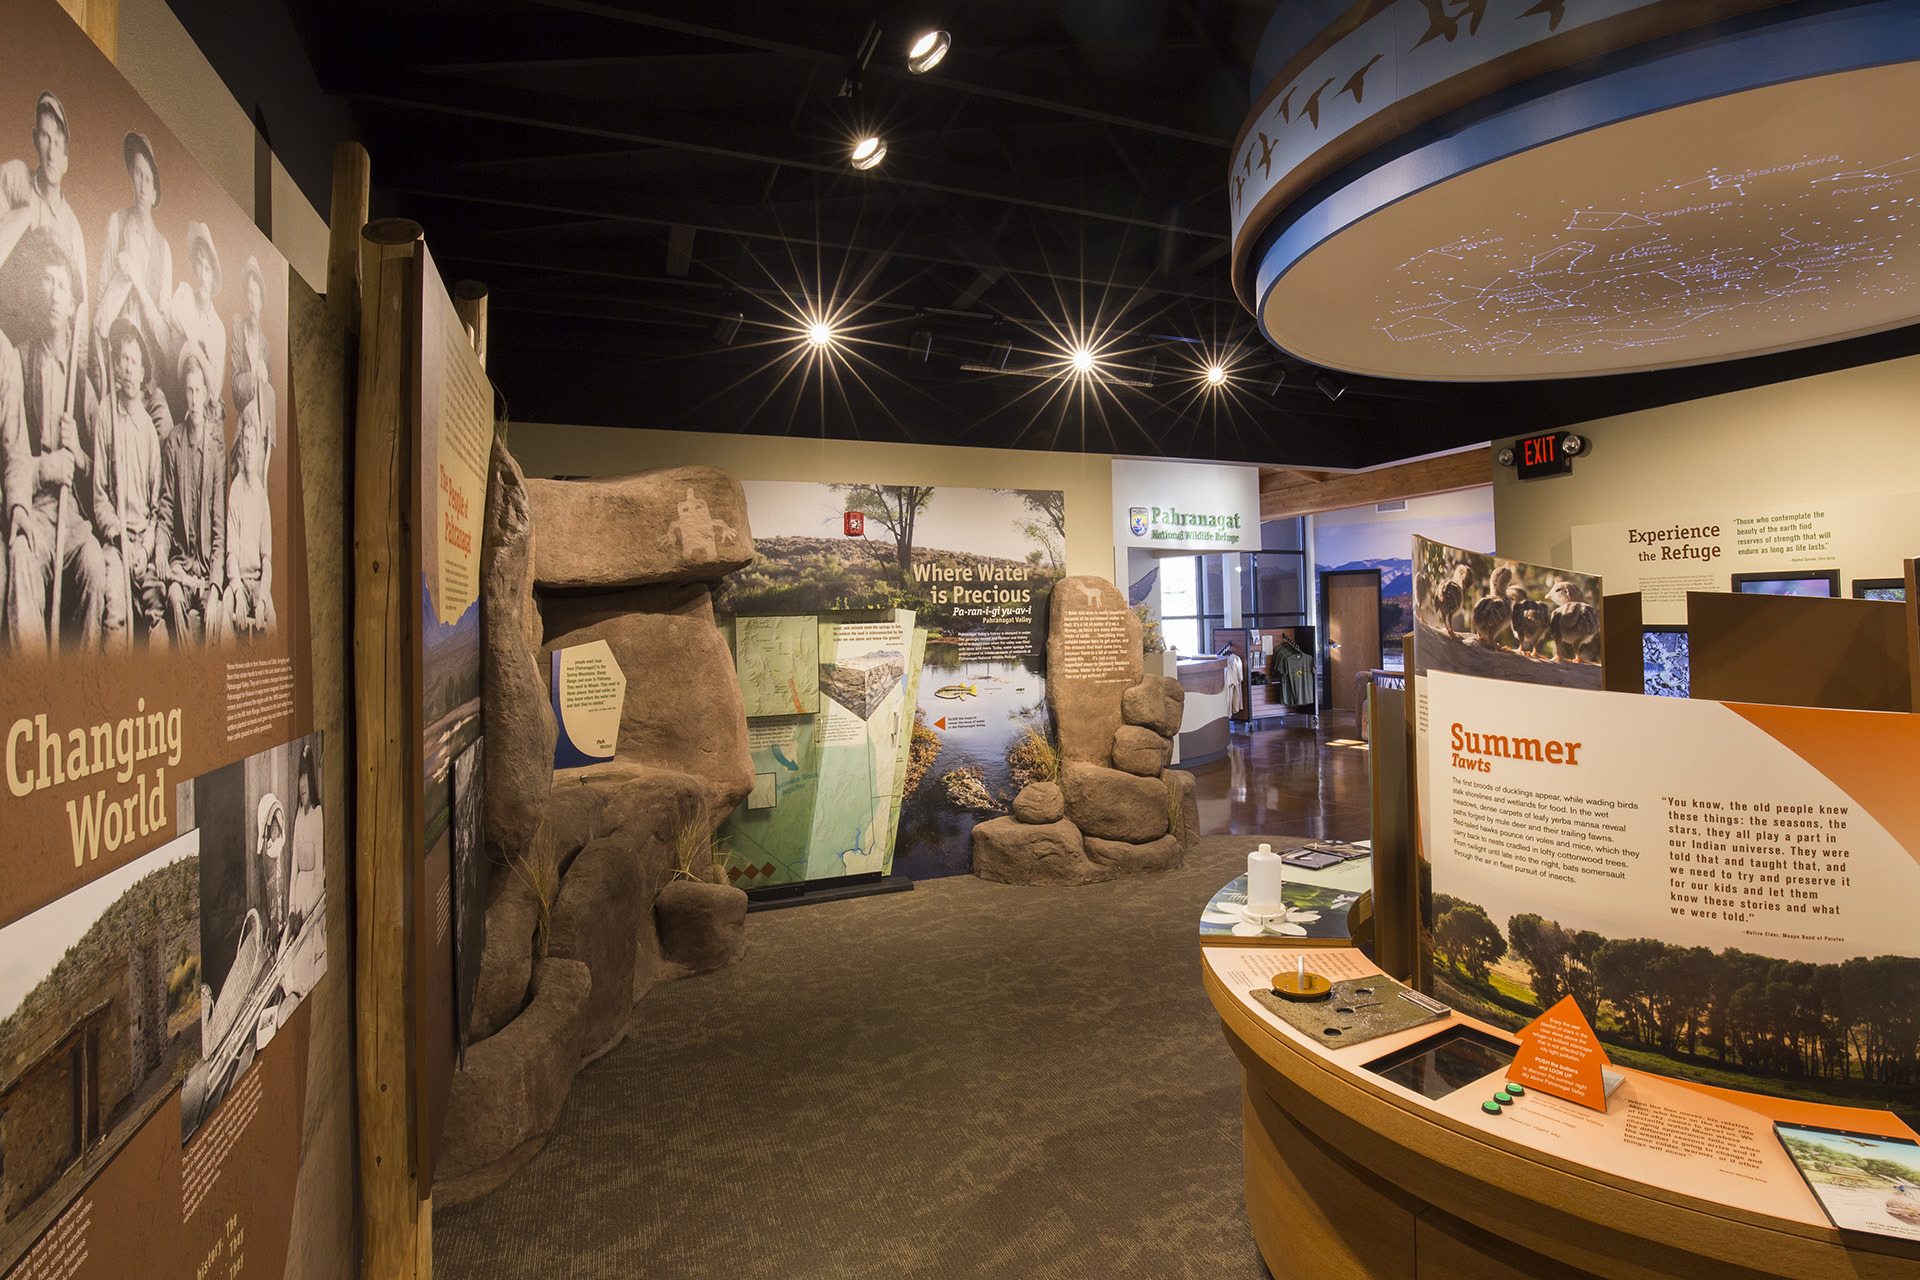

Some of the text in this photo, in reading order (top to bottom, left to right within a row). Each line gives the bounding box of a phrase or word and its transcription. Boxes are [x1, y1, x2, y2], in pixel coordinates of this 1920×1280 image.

[1717, 154, 1840, 183] Cassiopeia
[1832, 178, 1903, 196] Perseus
[1645, 201, 1732, 220] Cepheus
[1441, 237, 1504, 253] Cygnus
[1524, 436, 1555, 466] EXIT
[440, 464, 468, 520] The People of
[1152, 506, 1240, 531] Pahranagat
[1756, 515, 1769, 524] who
[1771, 512, 1811, 522] contemplate
[445, 512, 471, 559] Pahranagat
[1152, 530, 1240, 544] National Wildlife Refuge
[1628, 525, 1720, 546] Experience
[1774, 534, 1801, 543] strength
[1638, 544, 1721, 561] the Refuge
[913, 563, 1030, 582] Where Water
[930, 585, 1031, 604] is Precious
[953, 605, 1032, 617] Pa-ran-i-gi yu-av-i
[6, 697, 182, 797] Changing
[1451, 722, 1582, 765] Summer
[1452, 753, 1491, 773] Tawts
[1462, 778, 1472, 786] first
[1474, 780, 1493, 790] broods
[1502, 785, 1533, 799] ducklings
[1535, 793, 1562, 802] appear,
[1564, 794, 1584, 804] while
[1586, 797, 1615, 809] wading
[1617, 799, 1638, 809] birds
[1507, 798, 1536, 808] wetlands
[1538, 801, 1547, 810] for
[1549, 803, 1568, 813] food.
[1570, 805, 1577, 814] In
[1580, 806, 1592, 816] the
[1594, 809, 1609, 818] wet
[1662, 797, 1848, 815] “You know, the old people knew
[66, 767, 167, 868] World
[1668, 811, 1846, 829] these things: the seasons, the
[1669, 825, 1701, 836] stars,
[1707, 827, 1730, 840] they
[1736, 830, 1750, 839] all
[1756, 831, 1779, 843] play
[1797, 833, 1821, 844] part
[1826, 834, 1836, 843] in
[1692, 840, 1726, 851] Indian
[1732, 844, 1784, 855] universe.
[1790, 846, 1816, 858] They
[1669, 851, 1846, 872] told that and taught that, and
[1690, 869, 1715, 878] need
[1721, 870, 1732, 879] to
[1738, 871, 1754, 883] try
[1760, 874, 1780, 883] and
[1786, 877, 1836, 886] preserve
[1842, 877, 1850, 886] it
[1670, 878, 1685, 888] for
[1714, 883, 1737, 894] kids
[1744, 887, 1763, 896] and
[1769, 887, 1784, 897] let
[1790, 889, 1818, 899] them
[1670, 892, 1840, 915] know these stories and what
[1671, 907, 1754, 922] we were told.”
[1550, 1017, 1562, 1026] Enjoy
[1535, 1055, 1550, 1065] PUSH
[1560, 1063, 1578, 1074] buttons
[1549, 1067, 1563, 1075] LOOK
[226, 1214, 237, 1238] The
[230, 1227, 244, 1257] They
[197, 1238, 224, 1280] history.
[230, 1252, 244, 1280] They
